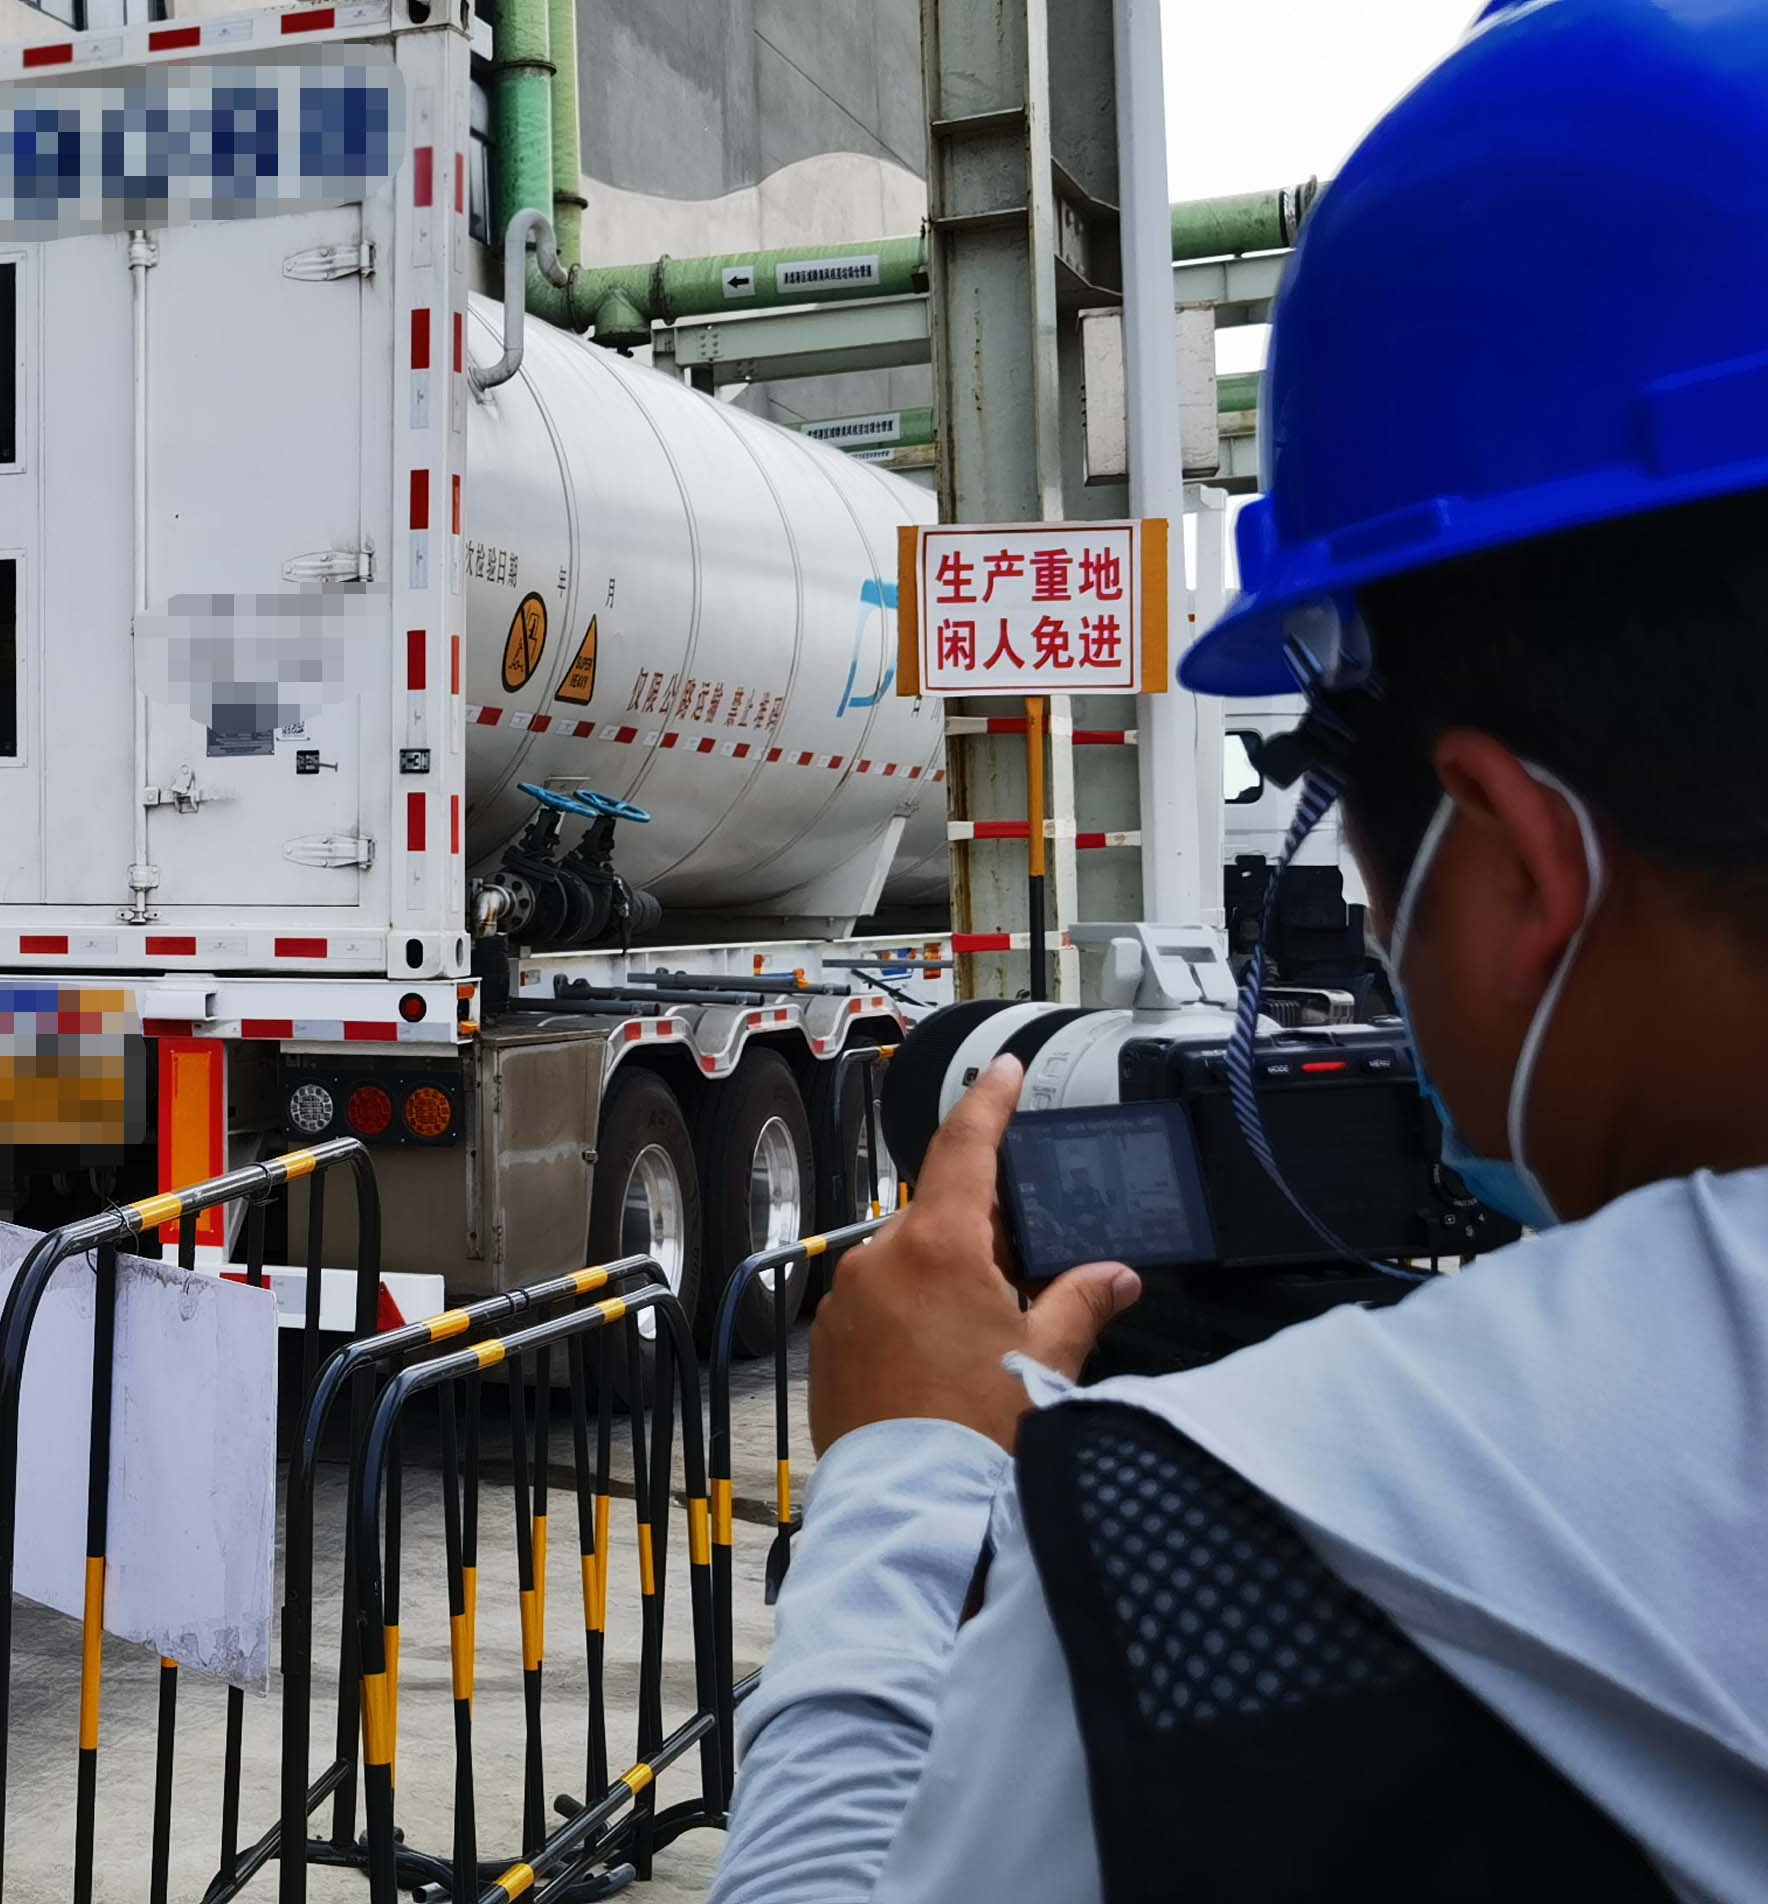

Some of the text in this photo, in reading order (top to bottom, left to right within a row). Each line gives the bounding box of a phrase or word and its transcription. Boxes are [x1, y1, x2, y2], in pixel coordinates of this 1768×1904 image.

[605, 578, 616, 608] 月
[935, 547, 1124, 604] 生产重地
[937, 613, 1122, 672] 闲人免进
